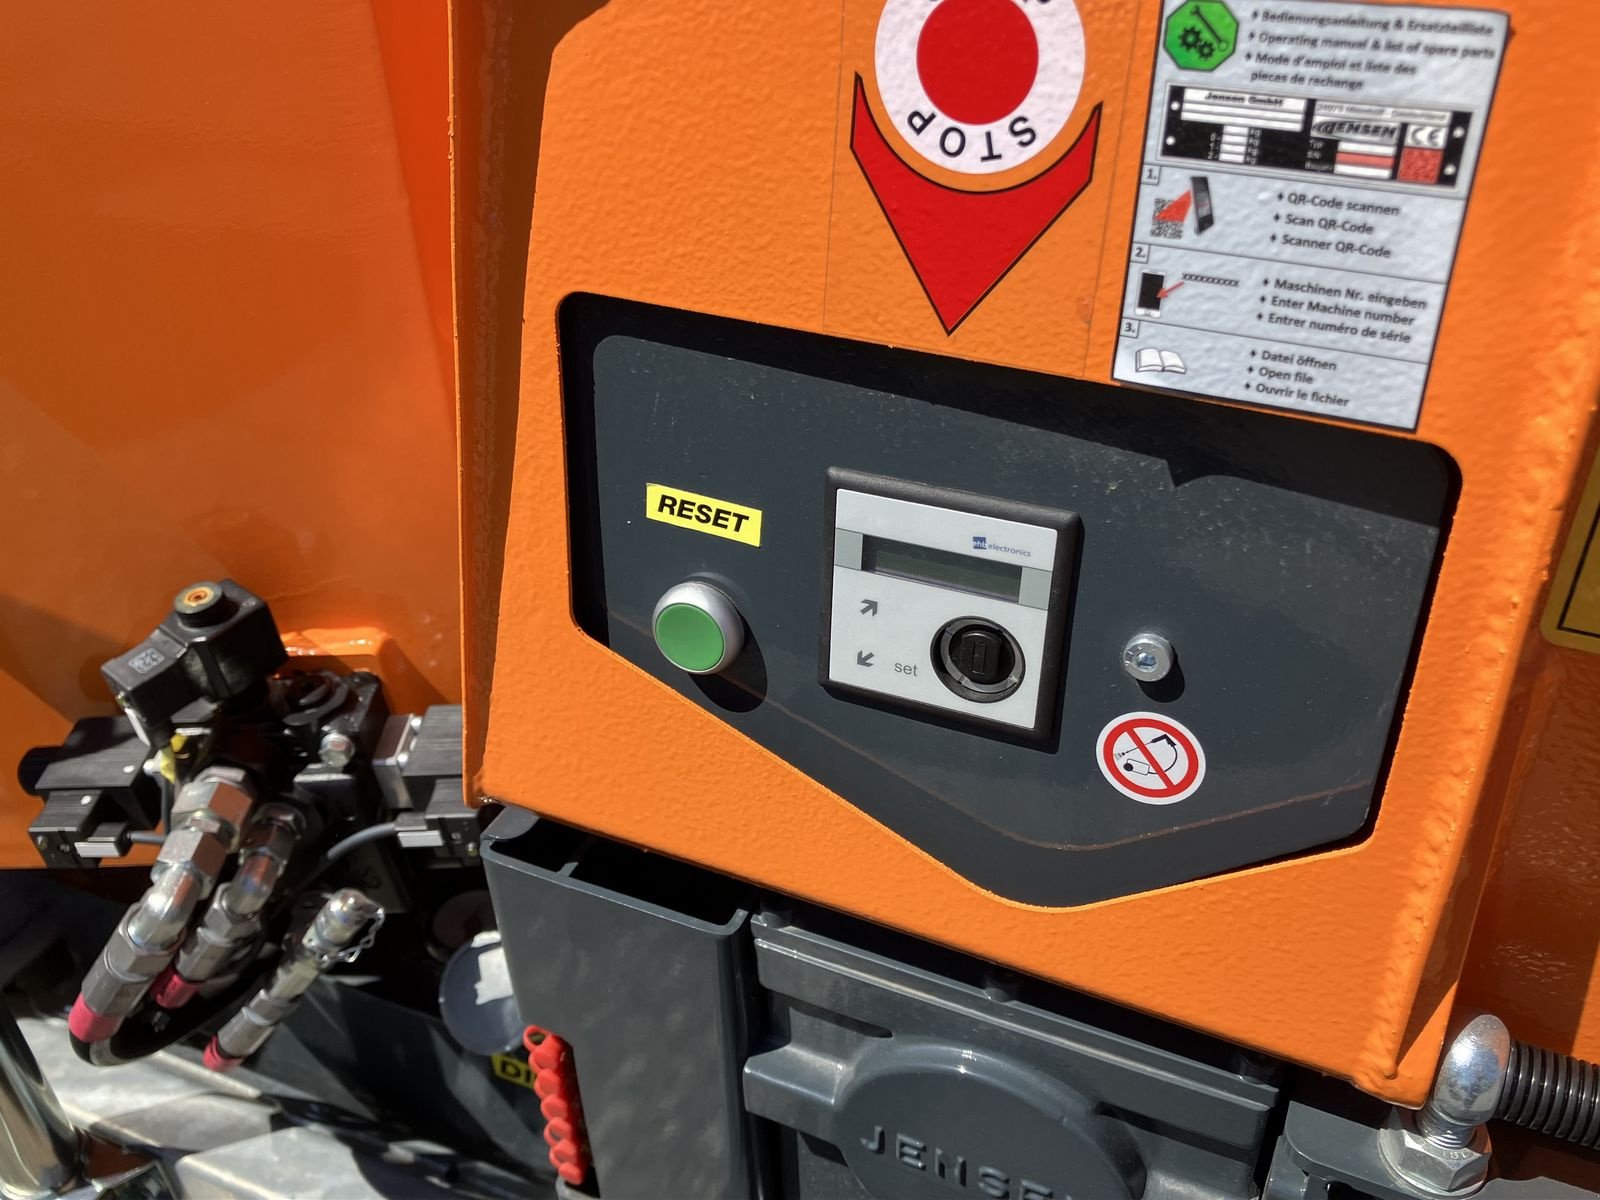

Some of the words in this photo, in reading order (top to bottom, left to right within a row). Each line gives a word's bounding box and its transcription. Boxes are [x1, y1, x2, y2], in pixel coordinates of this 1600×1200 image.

[1393, 17, 1403, 30] &
[1258, 32, 1318, 48] Operating
[1320, 38, 1368, 50] manual
[1370, 39, 1381, 51] &
[1384, 39, 1404, 52] list
[1406, 41, 1421, 53] of
[1423, 46, 1458, 59] spare
[1461, 47, 1495, 60] parts
[1255, 52, 1289, 66] Mode
[1348, 60, 1362, 71] et
[1364, 60, 1390, 73] liste
[1394, 62, 1416, 75] des
[1250, 71, 1287, 84] pieces
[1290, 71, 1305, 84] de
[1307, 74, 1363, 90] rechange
[907, 109, 1037, 163] STOP
[1144, 168, 1158, 181] 1.
[1288, 192, 1342, 212] QR-Code
[1346, 202, 1401, 217] scannen
[1284, 212, 1314, 228] Scan
[1318, 215, 1374, 236] QR-Code
[1134, 247, 1147, 259] 2.
[1280, 233, 1332, 251] Scanner
[1335, 237, 1391, 259] QR-Code
[1273, 277, 1341, 299] Maschinen
[1344, 287, 1364, 302] Nr.
[1367, 292, 1428, 312] eingeben
[1270, 295, 1303, 312] Enter
[1306, 299, 1362, 319] Machine
[1364, 309, 1415, 327] number
[1123, 322, 1136, 334] 3.
[1267, 312, 1306, 330] Entrer
[1309, 316, 1359, 337] numéro
[1361, 324, 1377, 340] de
[1379, 325, 1411, 344] série
[1260, 349, 1293, 366] Datei
[1297, 352, 1338, 372] öffnen
[1258, 365, 1291, 383] Open
[1293, 369, 1315, 385] file
[1255, 382, 1295, 400] Ouvrir
[1297, 387, 1308, 400] le
[1310, 388, 1350, 408] fichier
[657, 494, 750, 533] RESET
[988, 543, 1032, 558] electronics
[893, 660, 919, 679] set
[859, 1124, 1072, 1200] JENSE
